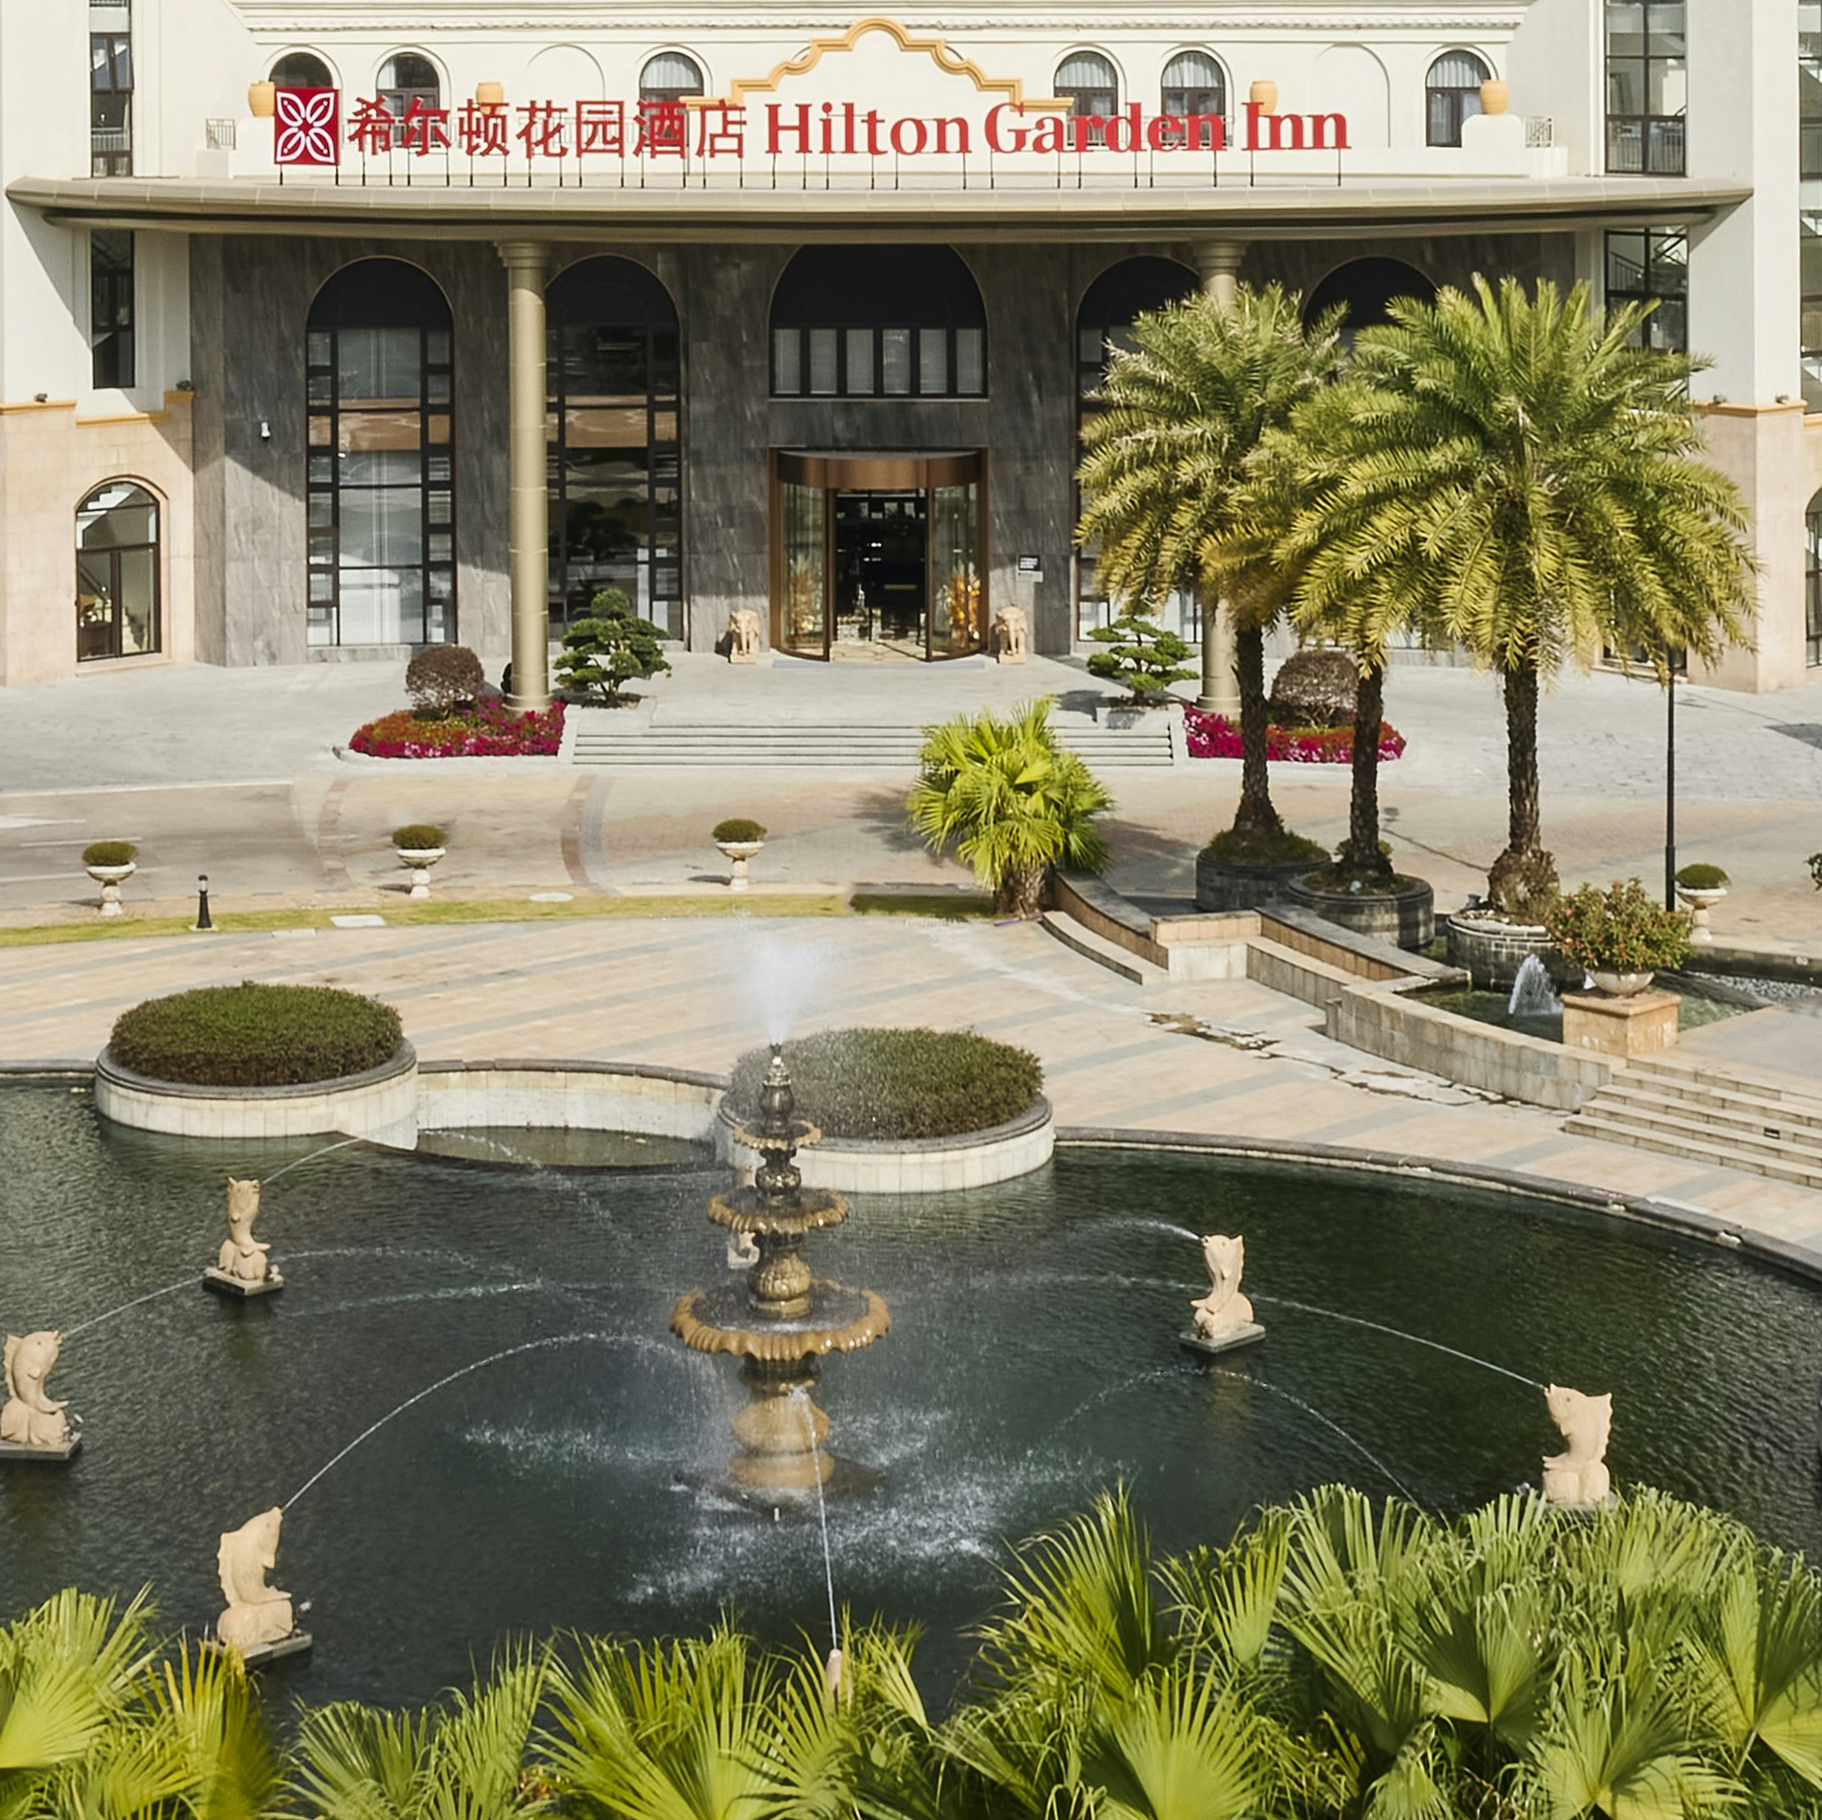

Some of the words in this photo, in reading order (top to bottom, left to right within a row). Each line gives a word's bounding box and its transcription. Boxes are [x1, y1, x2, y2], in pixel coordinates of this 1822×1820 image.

[347, 95, 747, 159] 希尔顿花园酒店
[764, 102, 970, 156] Hilton
[984, 102, 1226, 154] Garden
[1242, 101, 1350, 151] Inn
